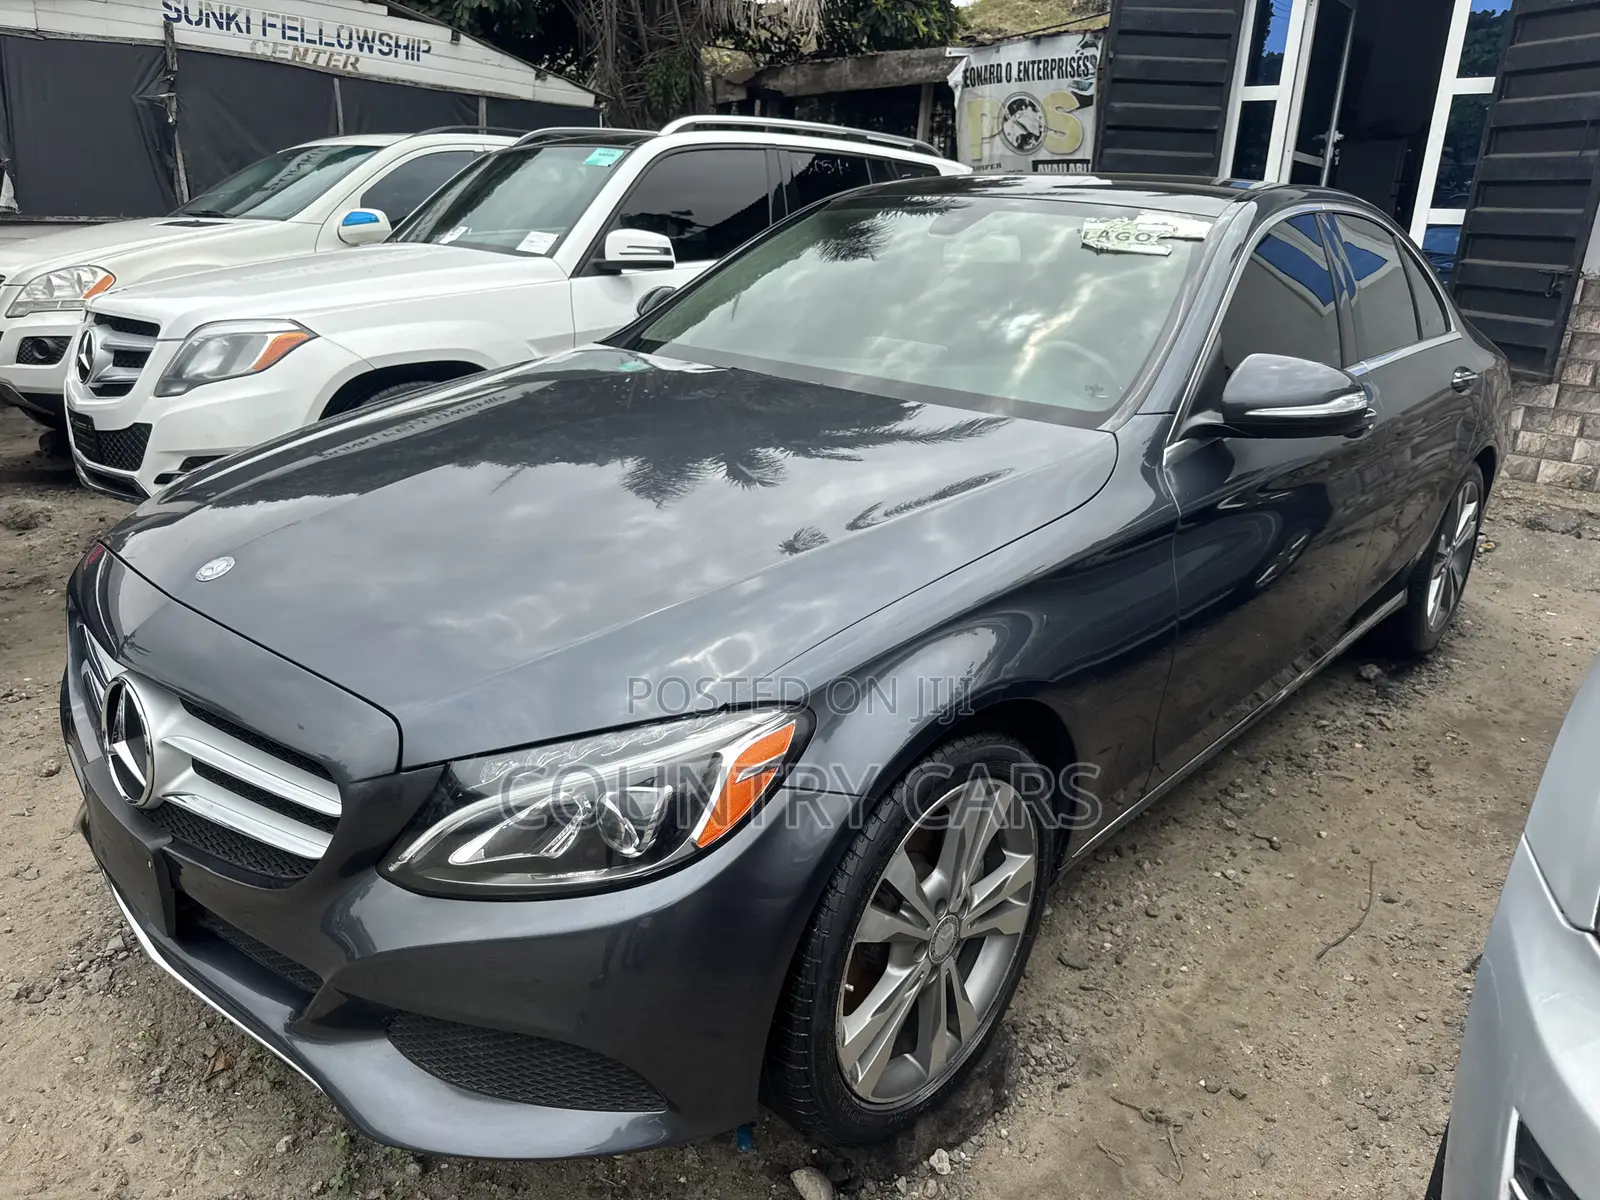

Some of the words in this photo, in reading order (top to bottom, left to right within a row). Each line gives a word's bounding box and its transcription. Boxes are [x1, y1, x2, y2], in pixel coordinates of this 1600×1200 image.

[162, 0, 251, 34] SUNKI
[262, 11, 432, 62] FELLOWSHIP
[251, 39, 360, 72] CENTER
[962, 63, 1003, 88] EONARD
